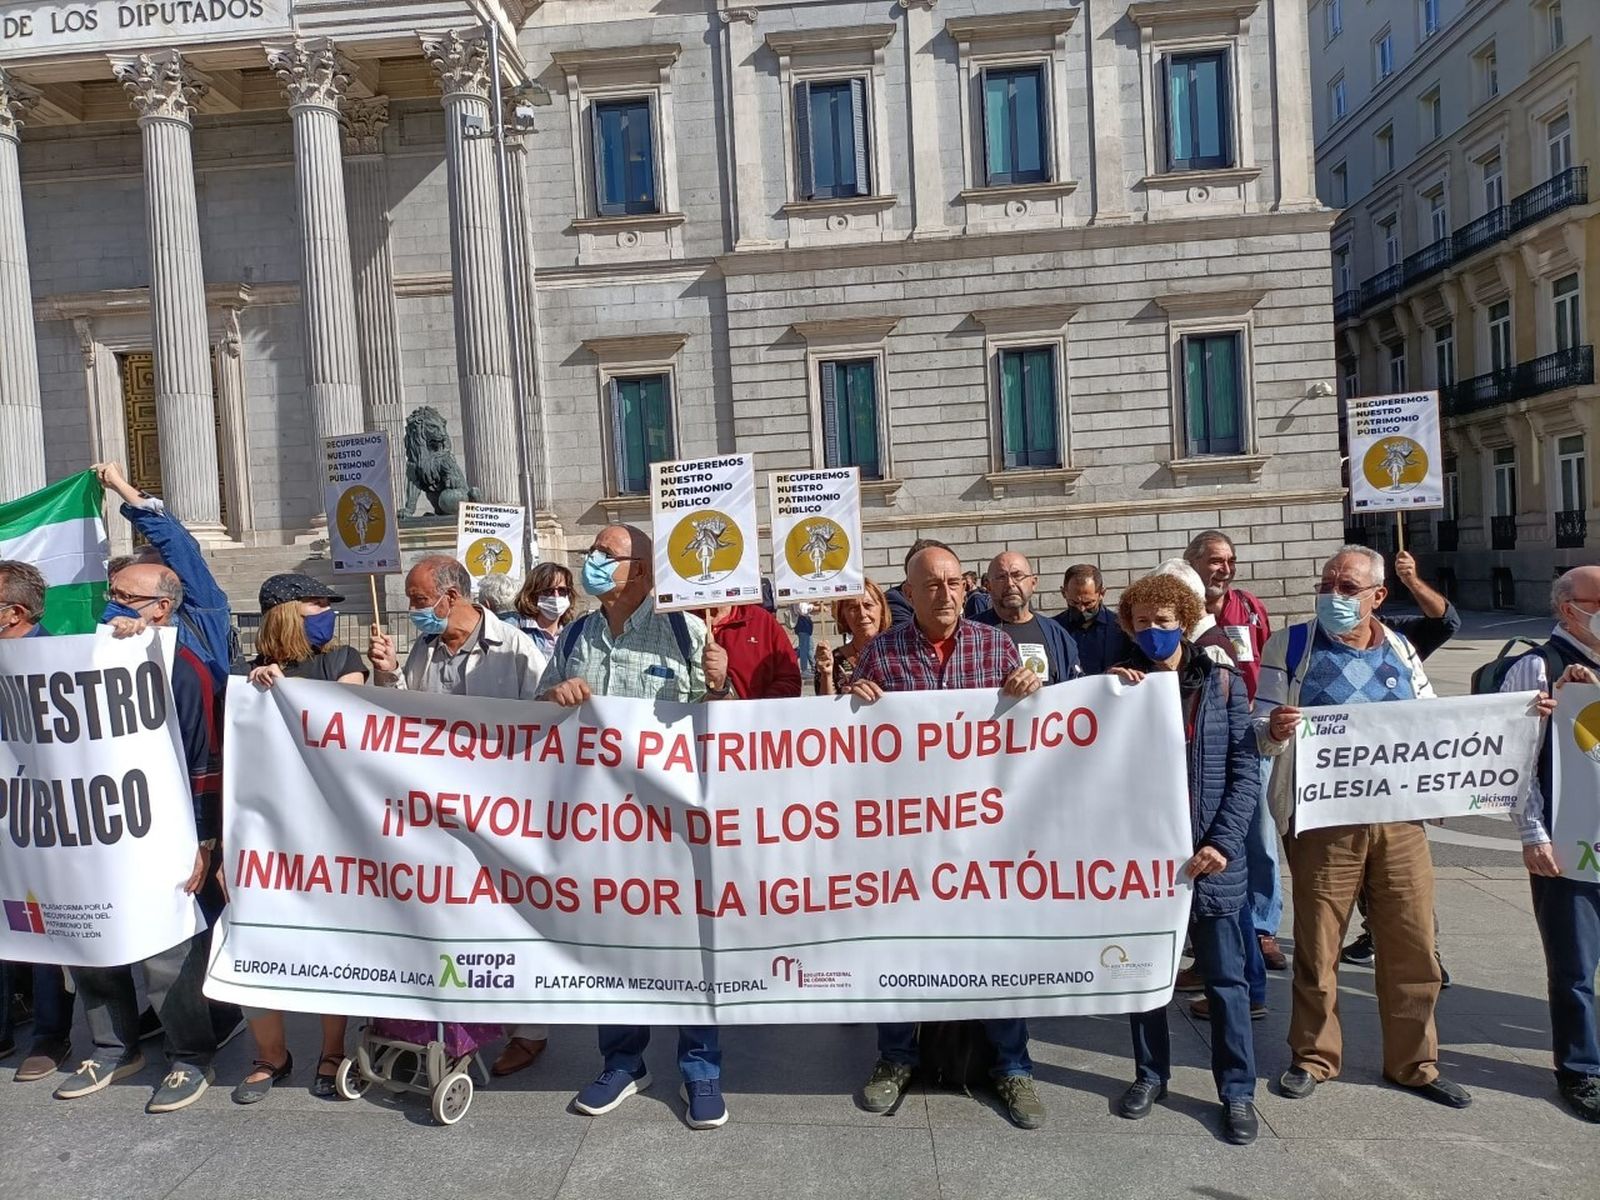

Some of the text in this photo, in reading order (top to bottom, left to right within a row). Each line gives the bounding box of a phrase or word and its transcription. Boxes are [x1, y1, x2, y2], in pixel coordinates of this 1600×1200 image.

[3, 0, 265, 39] DE LOS DIPUTADOS
[1356, 396, 1429, 408] RECUPEREMOS
[1356, 408, 1401, 417] NUESTRO
[1357, 415, 1419, 426] PATRIMONIO
[1357, 426, 1400, 435] PÚBLICO
[326, 436, 382, 448] RECUPEREMOS
[327, 450, 362, 460] NUESTRO
[328, 460, 375, 471] PATRIMONIO
[660, 457, 744, 474] RECUPEREMOS
[329, 472, 362, 482] PÚBLICO
[660, 473, 713, 485] NUESTRO
[776, 471, 850, 483] RECUPEREMOS
[661, 482, 733, 498] PATRIMONIO
[777, 483, 823, 494] NUESTRO
[662, 496, 711, 510] PÚBLICO
[778, 493, 841, 504] PATRIMONIO
[465, 505, 519, 514] RECUPEREMOS
[778, 504, 822, 515] PÚBLICO
[464, 520, 511, 528] PATRIMONIO
[0, 660, 166, 745] NUESTRO
[1311, 713, 1350, 723] europa
[1316, 723, 1346, 736] laica
[301, 706, 1099, 774] LA MEZQUITA ES PATRIMONIO PÚBLICO
[1315, 731, 1504, 769] SEPARACIÓN
[1298, 778, 1391, 805] IGLESIA
[1416, 768, 1520, 795] ESTADO
[1477, 793, 1518, 803] laicismo
[381, 786, 1005, 848] ¡¡DEVOLUCIÓN DE LOS BIENES
[234, 848, 1176, 918] INMATRICULADOS POR LA IGLESIA CATÓLICA!!
[456, 953, 516, 968] europa
[234, 960, 435, 987] EUROPA LAICA-CÓRDOBA LAICA
[467, 970, 514, 988] laica
[879, 974, 988, 988] COORDINADORA
[992, 970, 1094, 987] RECUPERANDO
[534, 975, 768, 994] PLATAFORMA MEZQUITA-CATEDRAL
